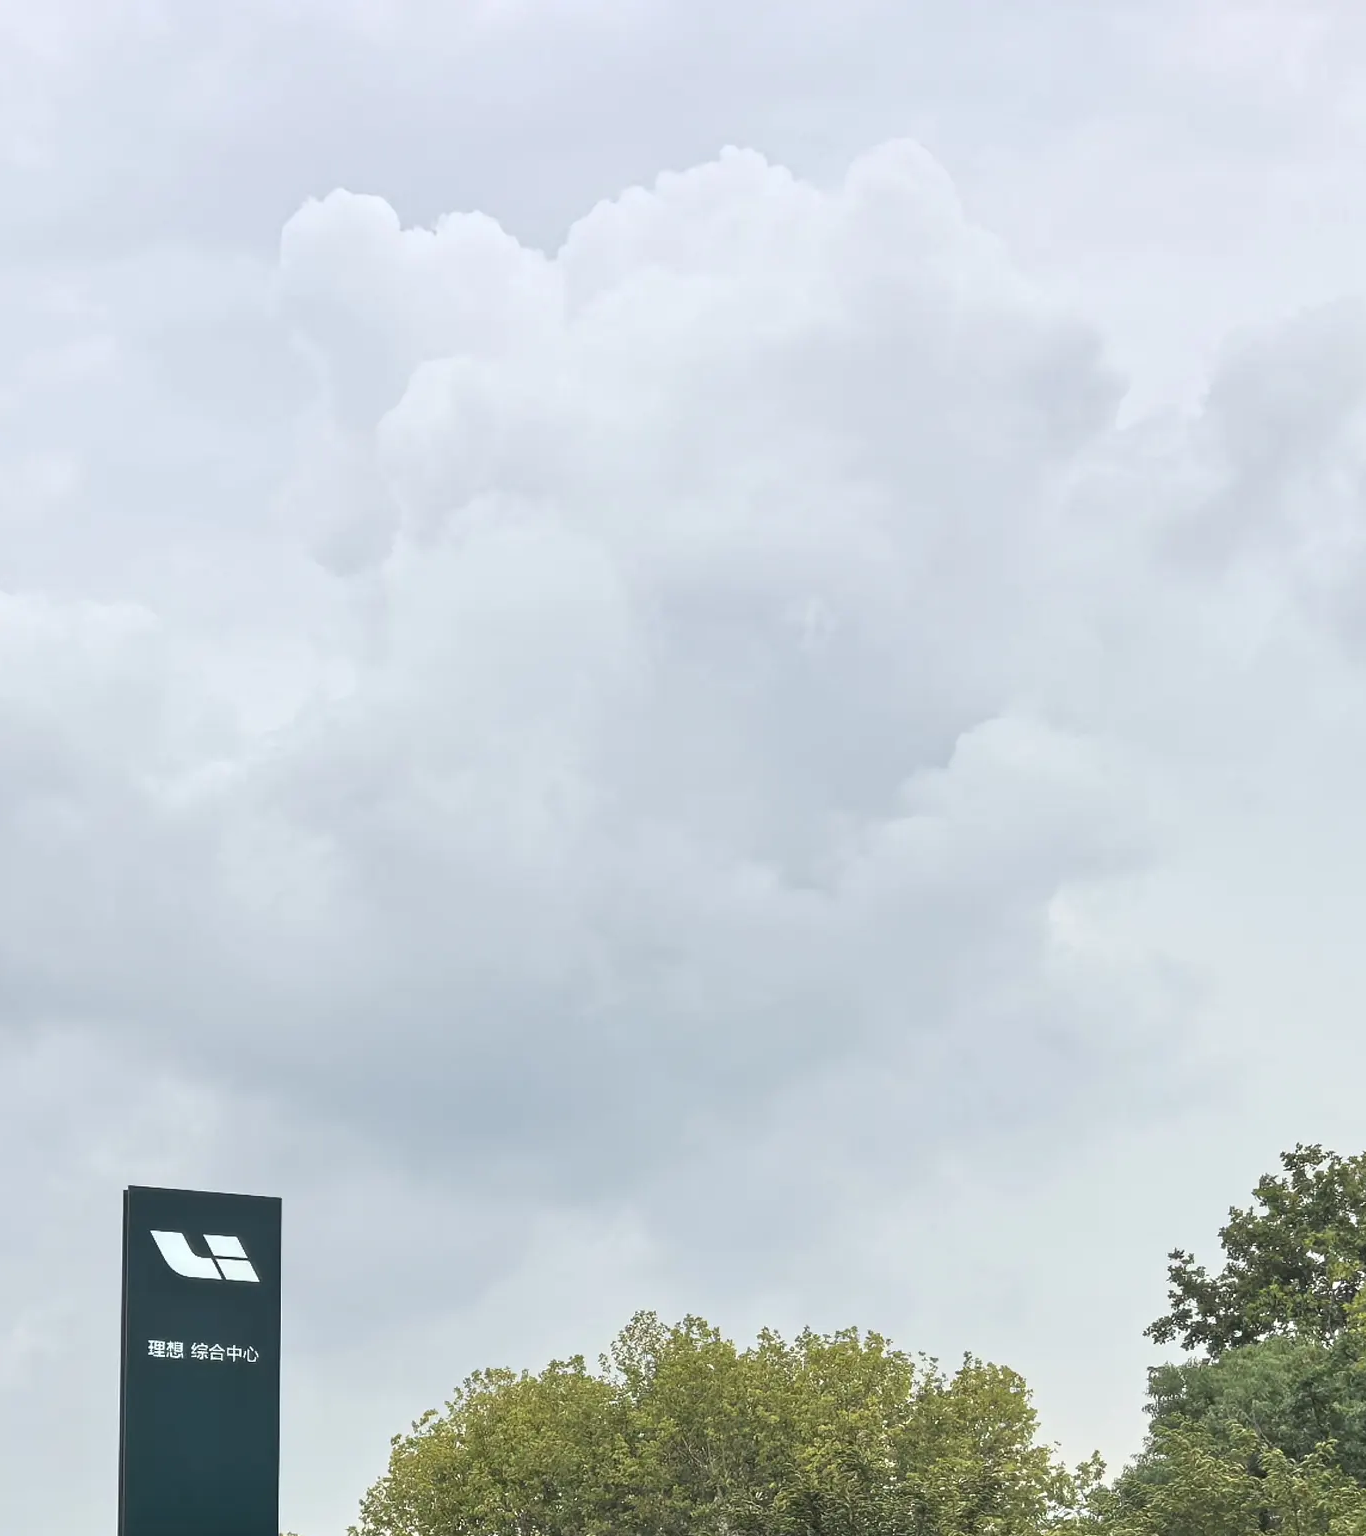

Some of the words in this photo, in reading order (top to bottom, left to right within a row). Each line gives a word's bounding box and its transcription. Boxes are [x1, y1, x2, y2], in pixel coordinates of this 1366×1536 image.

[147, 1339, 184, 1359] 理想
[190, 1342, 260, 1363] 综合中心
